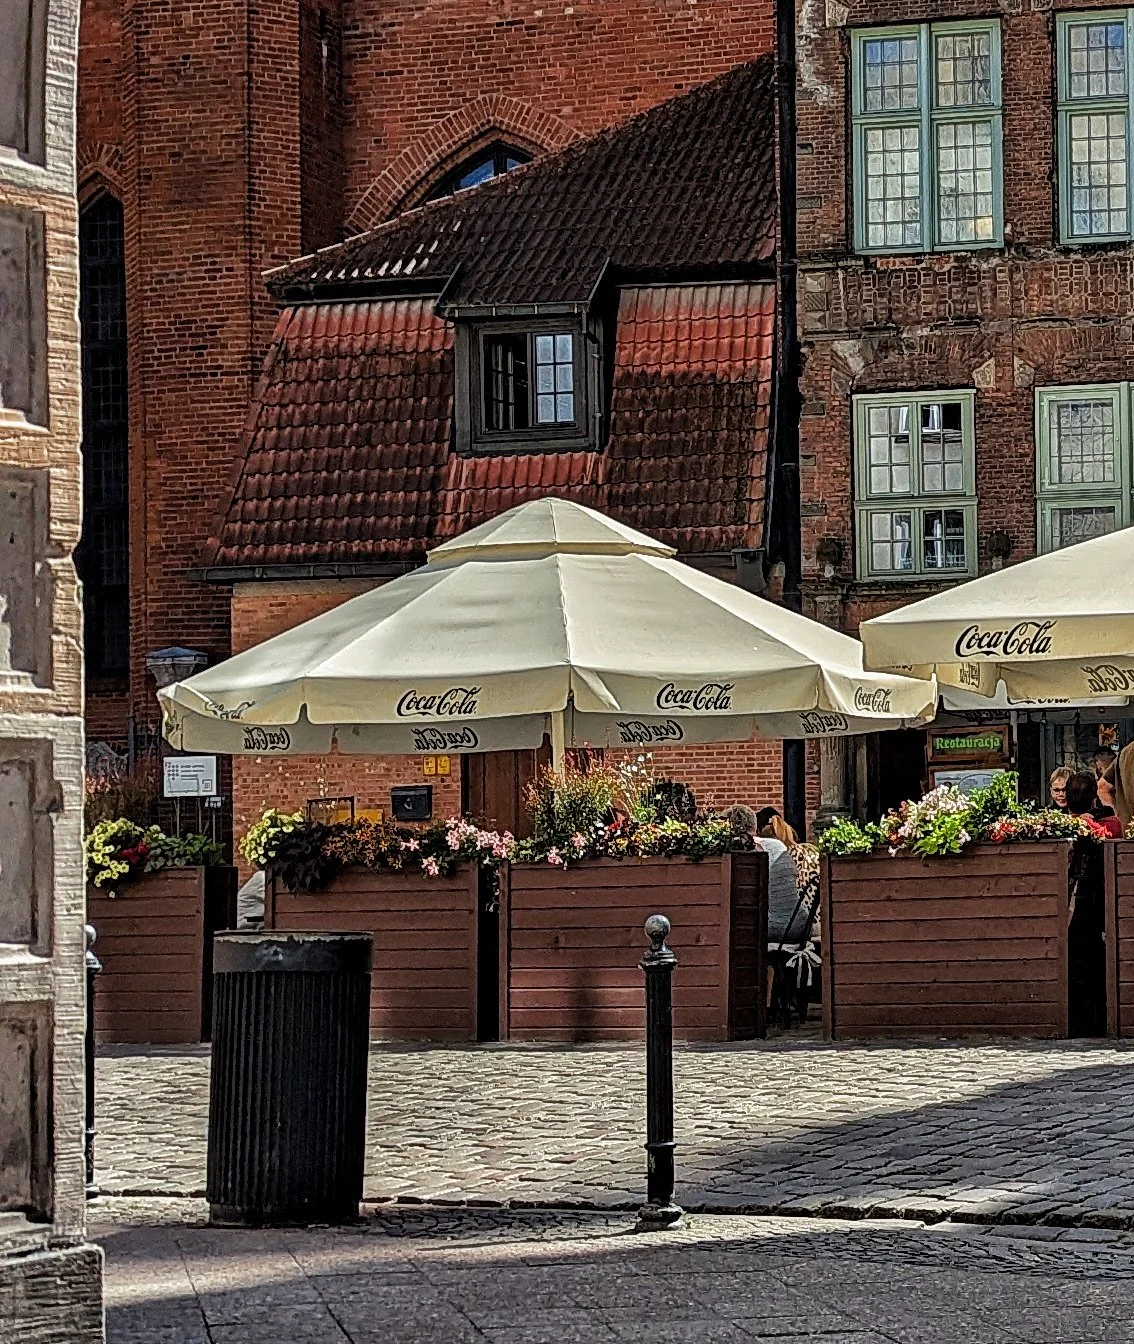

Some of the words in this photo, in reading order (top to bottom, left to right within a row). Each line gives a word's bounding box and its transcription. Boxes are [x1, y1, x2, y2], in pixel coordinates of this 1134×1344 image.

[955, 620, 1057, 657] Coca-Cola
[397, 686, 482, 717] Coca-Cola
[656, 682, 735, 711] Coca-Cola
[854, 686, 892, 713] Coca-Cola
[935, 736, 1001, 750] Restauracja
